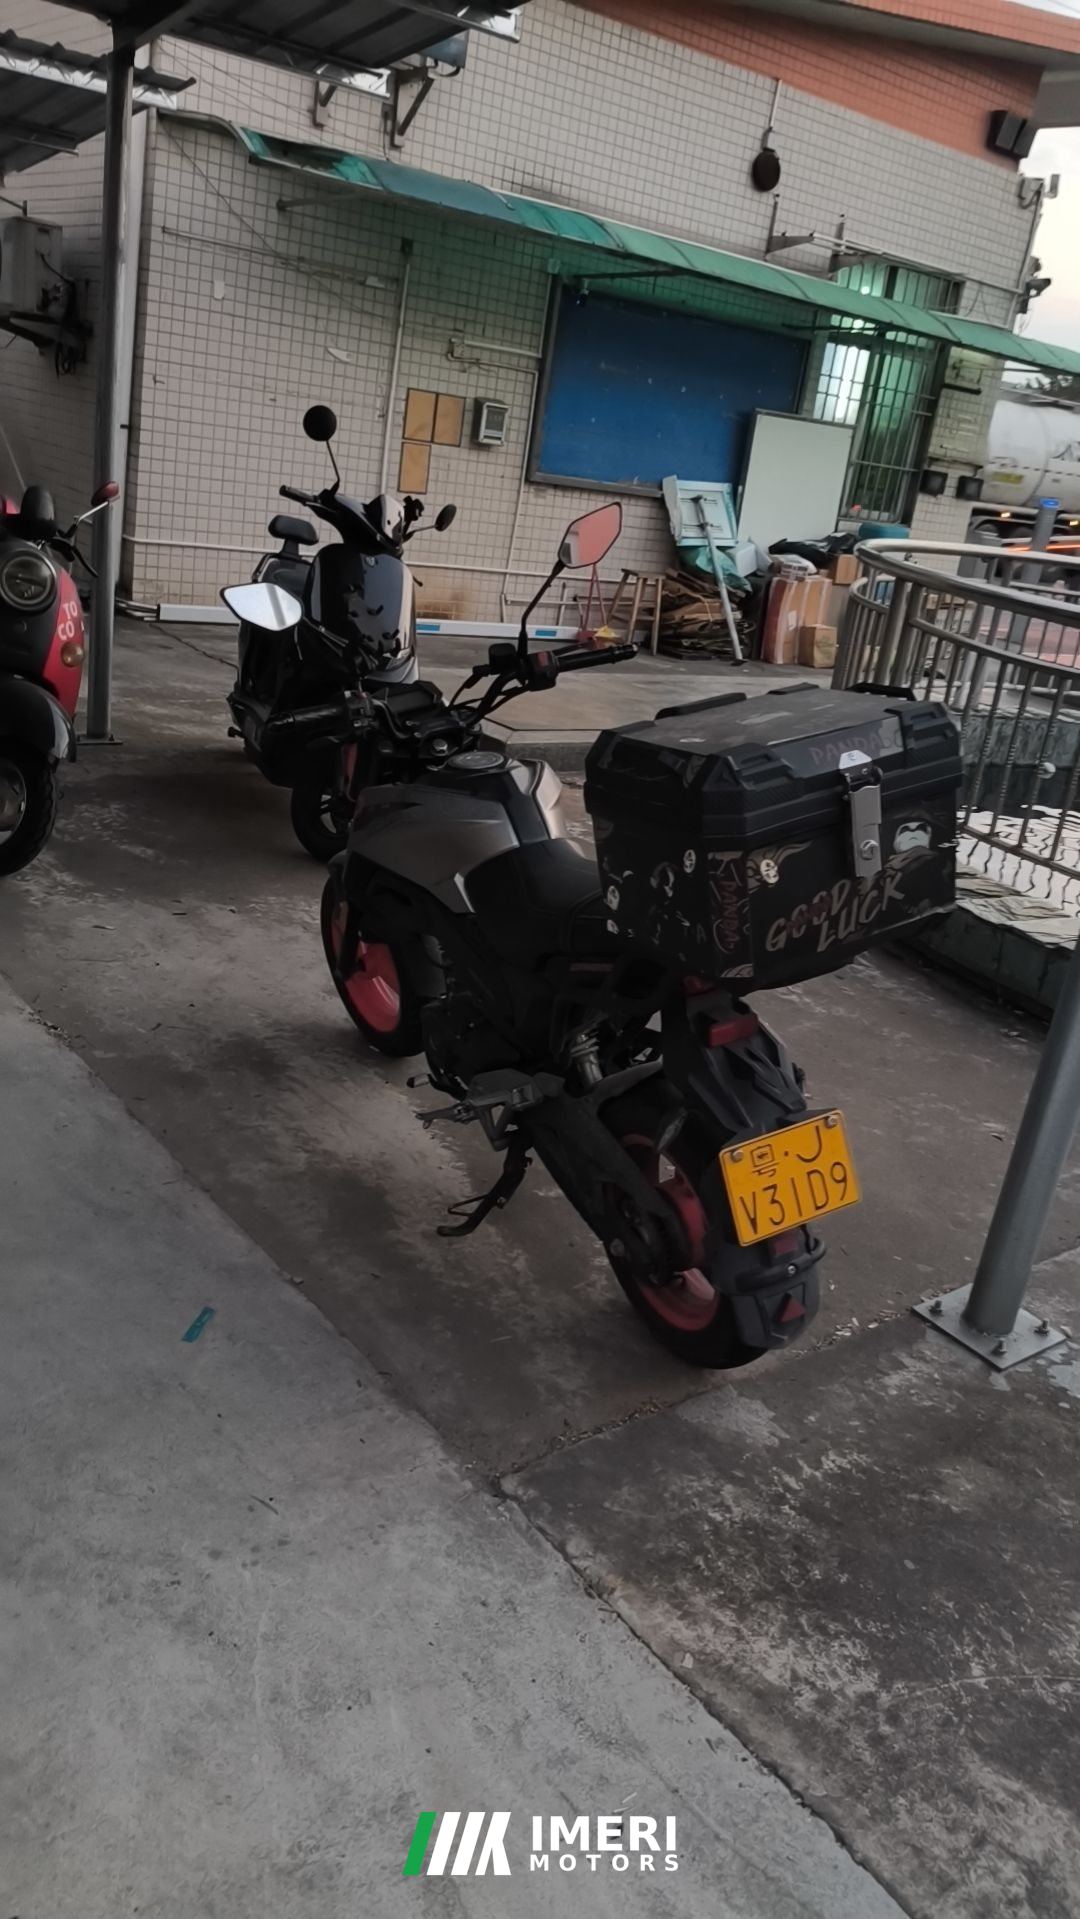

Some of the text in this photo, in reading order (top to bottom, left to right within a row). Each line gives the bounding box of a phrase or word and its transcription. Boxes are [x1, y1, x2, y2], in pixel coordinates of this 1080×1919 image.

[63, 601, 78, 620] TO
[765, 878, 852, 952] GOOD
[816, 871, 906, 953] LUCK
[739, 1161, 848, 1235] V31D9
